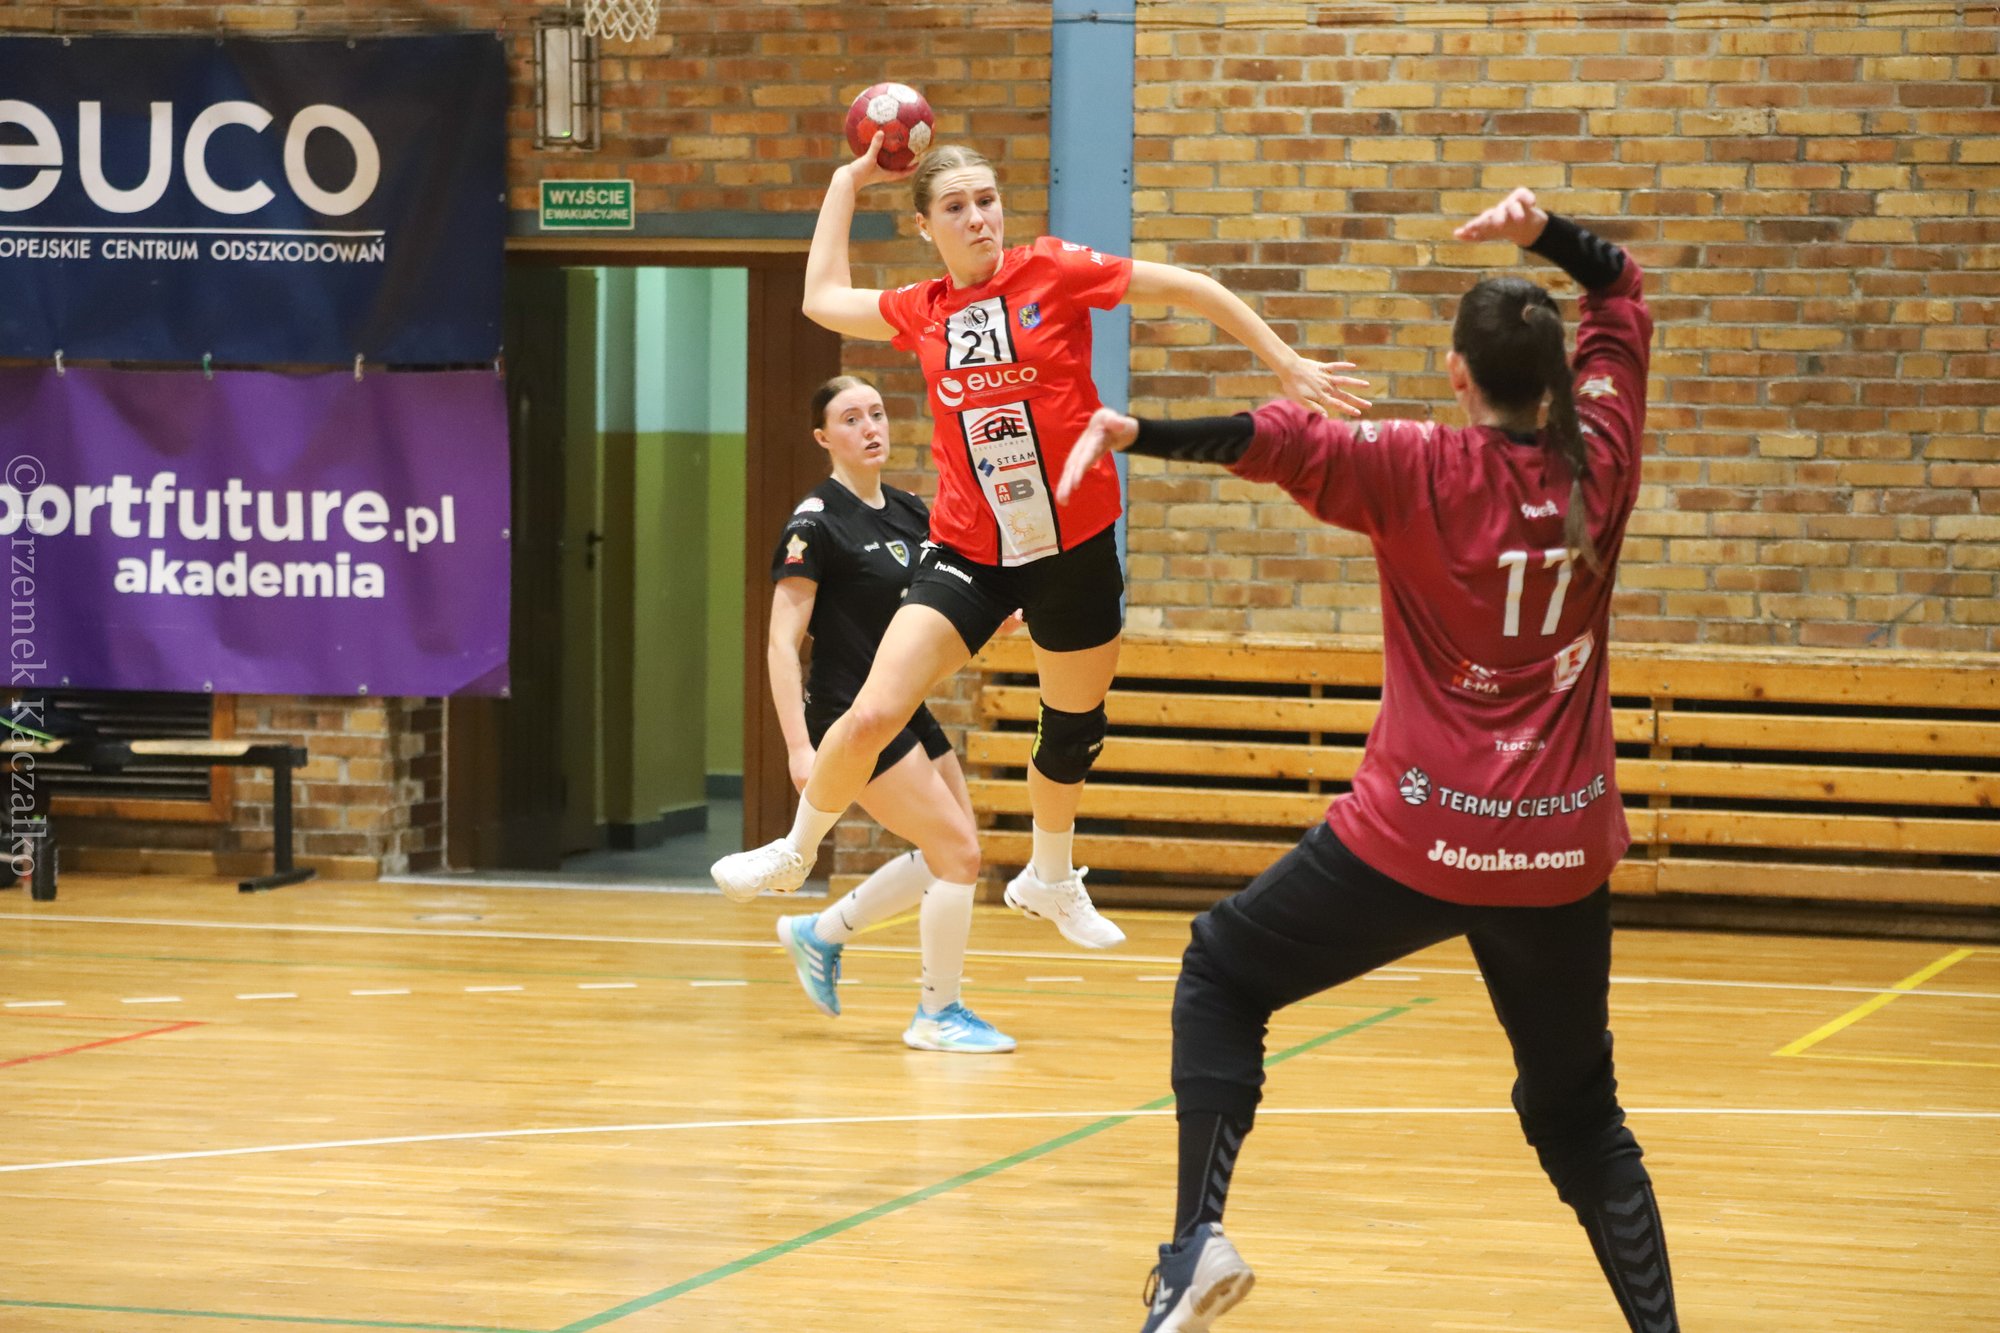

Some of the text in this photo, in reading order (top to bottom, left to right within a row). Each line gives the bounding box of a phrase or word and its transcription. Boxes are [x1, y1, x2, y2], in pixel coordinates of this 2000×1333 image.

[0, 99, 380, 216] euco
[549, 186, 625, 205] WYJŚCIE
[545, 209, 629, 220] EWAKUACYJNE
[101, 239, 199, 260] CENTRUM
[210, 238, 385, 263] ODSZKODOWAŃ
[960, 328, 1002, 366] 21
[967, 366, 1038, 391] euco
[984, 416, 1028, 442] GAL
[996, 451, 1036, 466] STEAM
[114, 549, 385, 599] akademia
[934, 560, 973, 585] hummel
[1498, 549, 1581, 637] 17
[1439, 786, 1512, 818] TERMY
[1427, 839, 1585, 872] Jelonka.com
